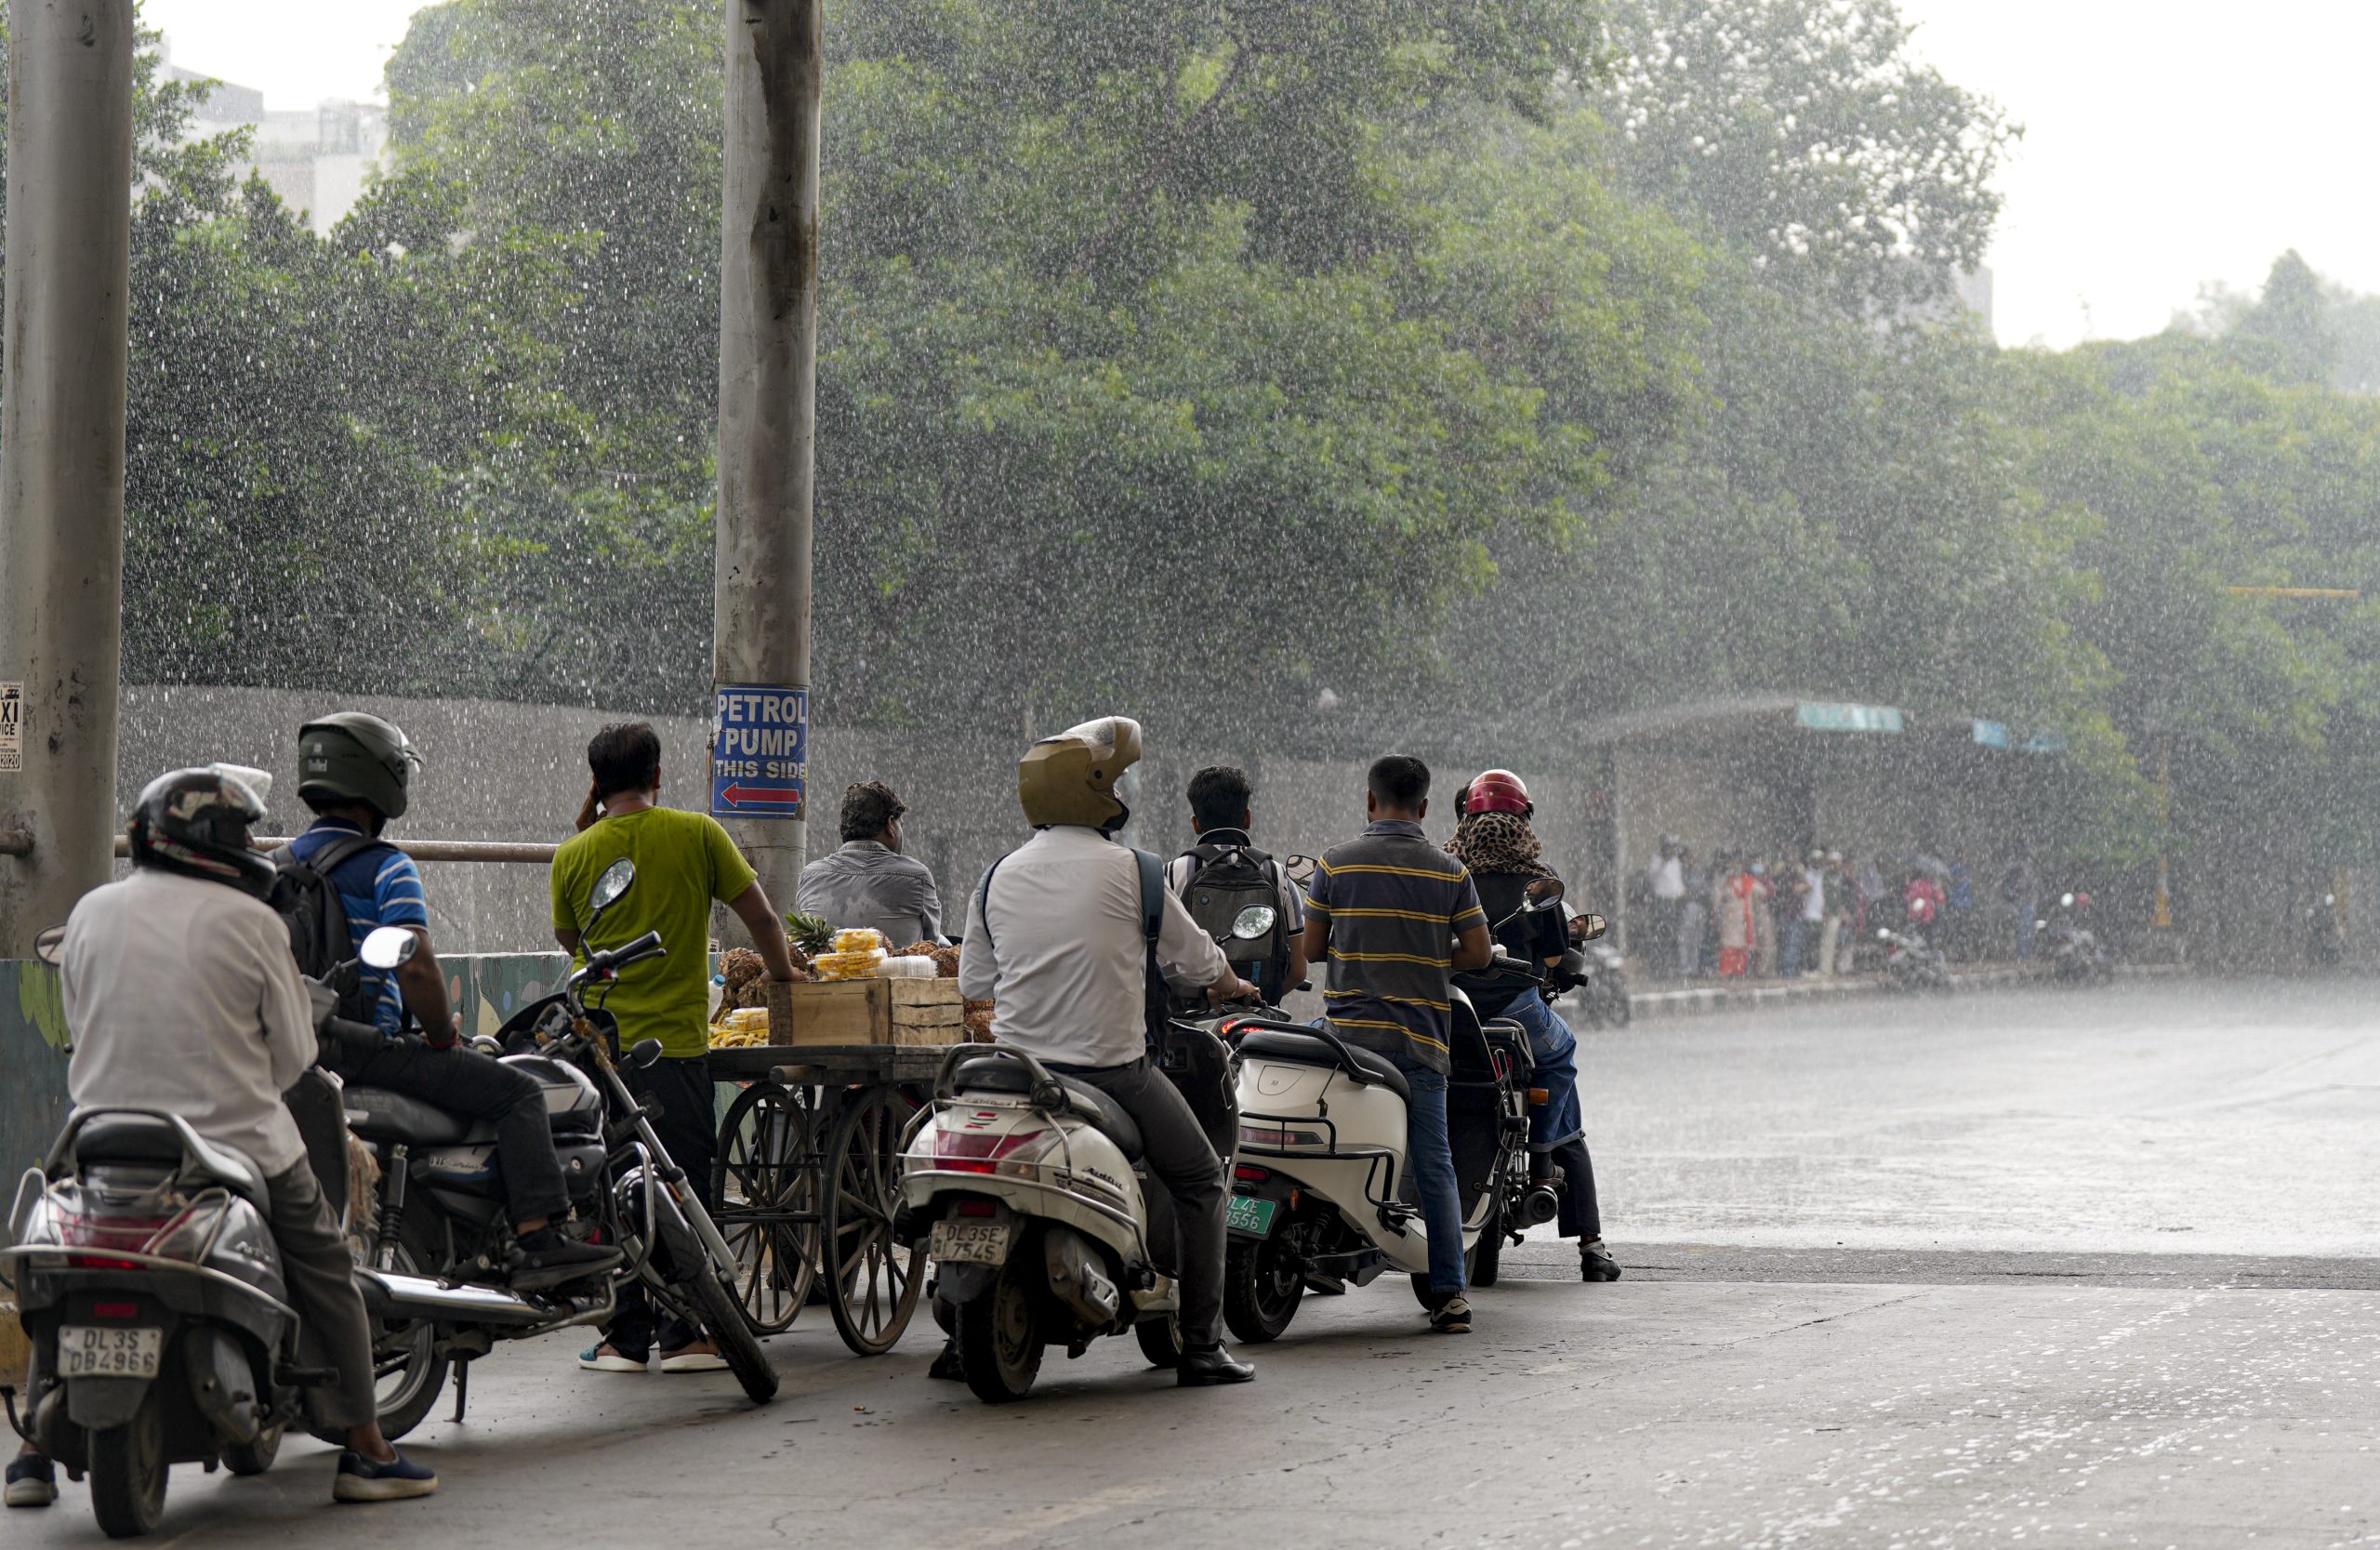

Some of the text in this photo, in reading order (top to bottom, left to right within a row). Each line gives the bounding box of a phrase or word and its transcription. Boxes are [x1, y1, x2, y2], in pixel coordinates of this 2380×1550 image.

[717, 694, 806, 723] PETROL
[0, 722, 15, 735] ICE
[725, 727, 798, 756] PUMP
[0, 754, 20, 768] 2020
[715, 760, 806, 779] THIS SIDE
[1226, 1197, 1261, 1214] L4E
